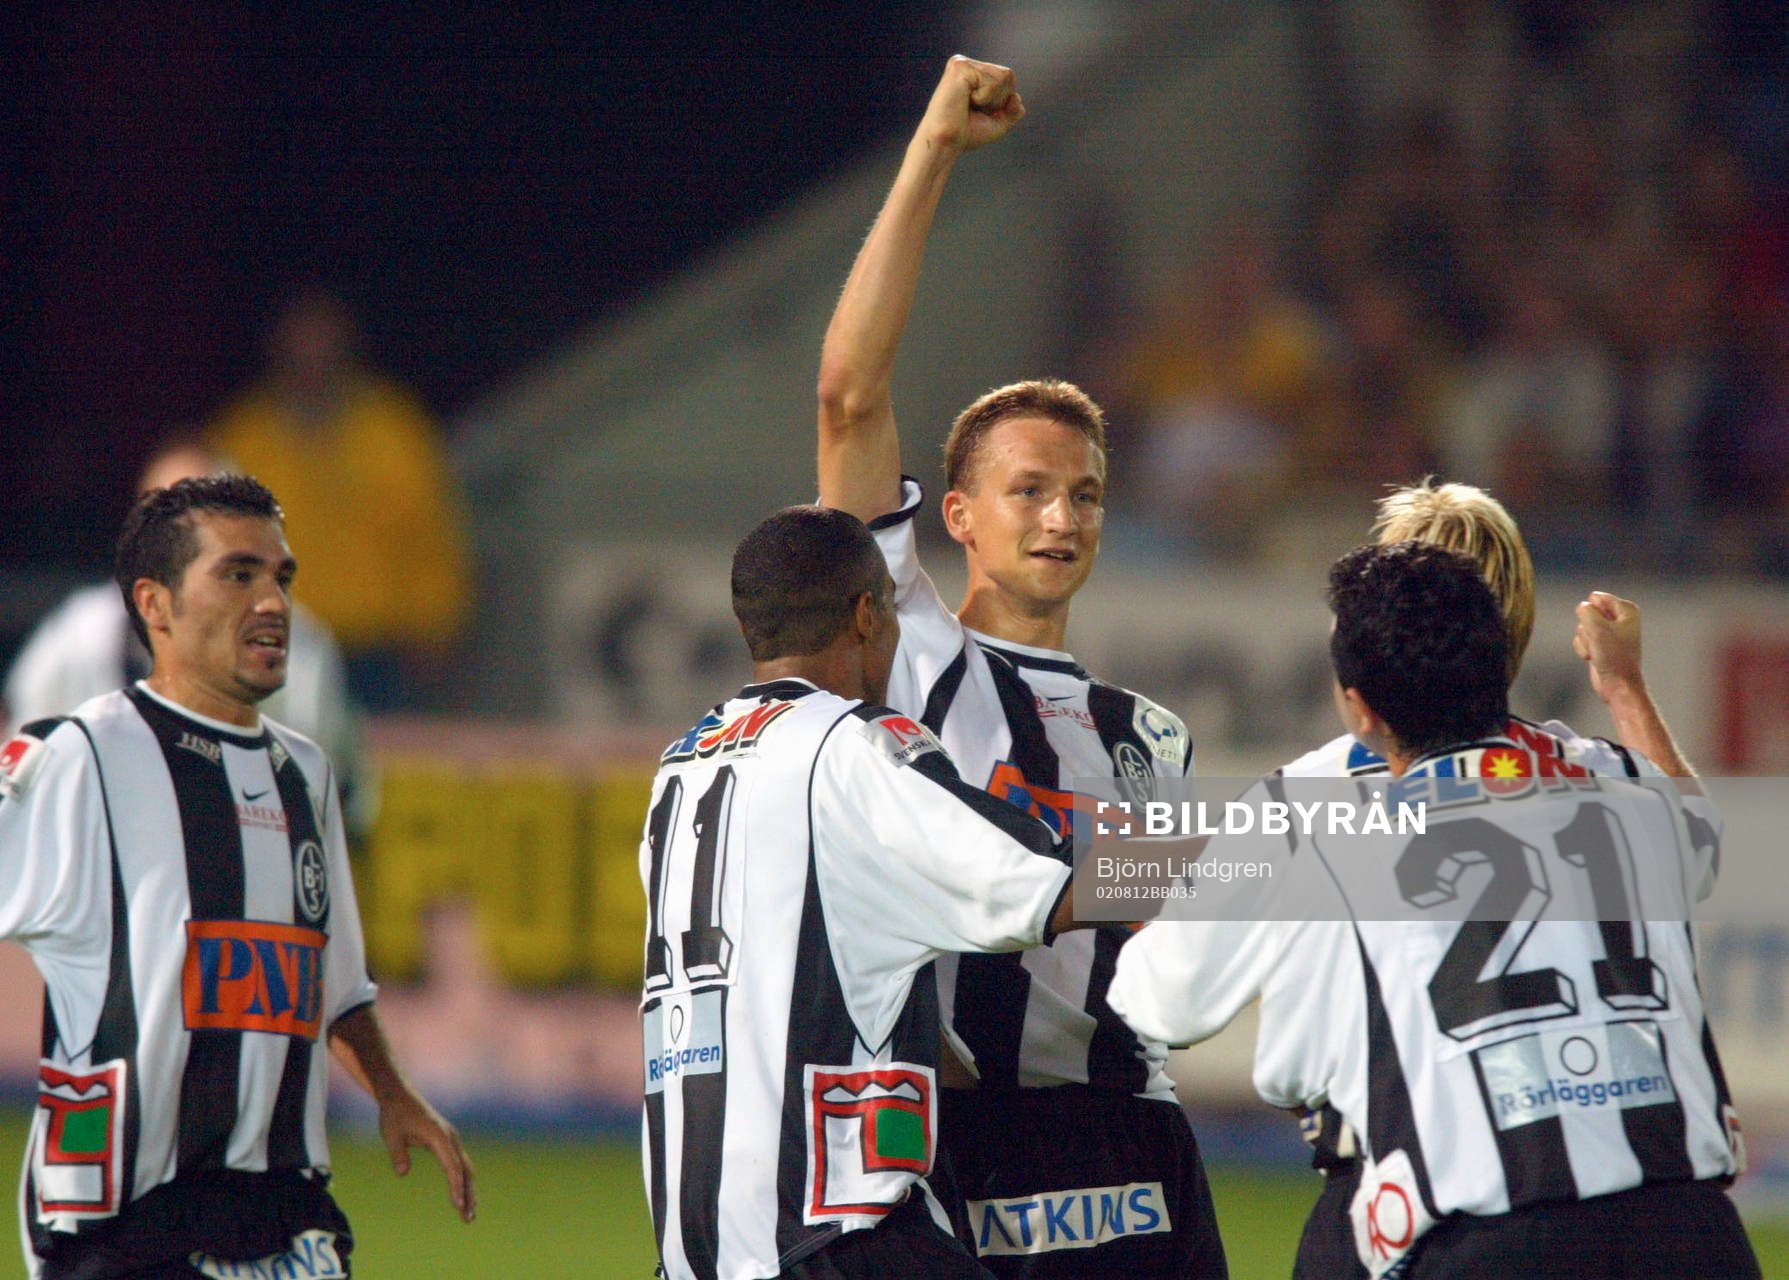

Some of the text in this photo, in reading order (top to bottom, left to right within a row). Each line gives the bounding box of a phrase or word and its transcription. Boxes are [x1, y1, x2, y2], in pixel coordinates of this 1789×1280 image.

[645, 764, 737, 994] 11
[1395, 802, 1668, 1042] 21
[196, 937, 323, 1022] PNB
[1499, 1075, 1667, 1116] Rörläggaren
[979, 1188, 1160, 1248] ATKINS
